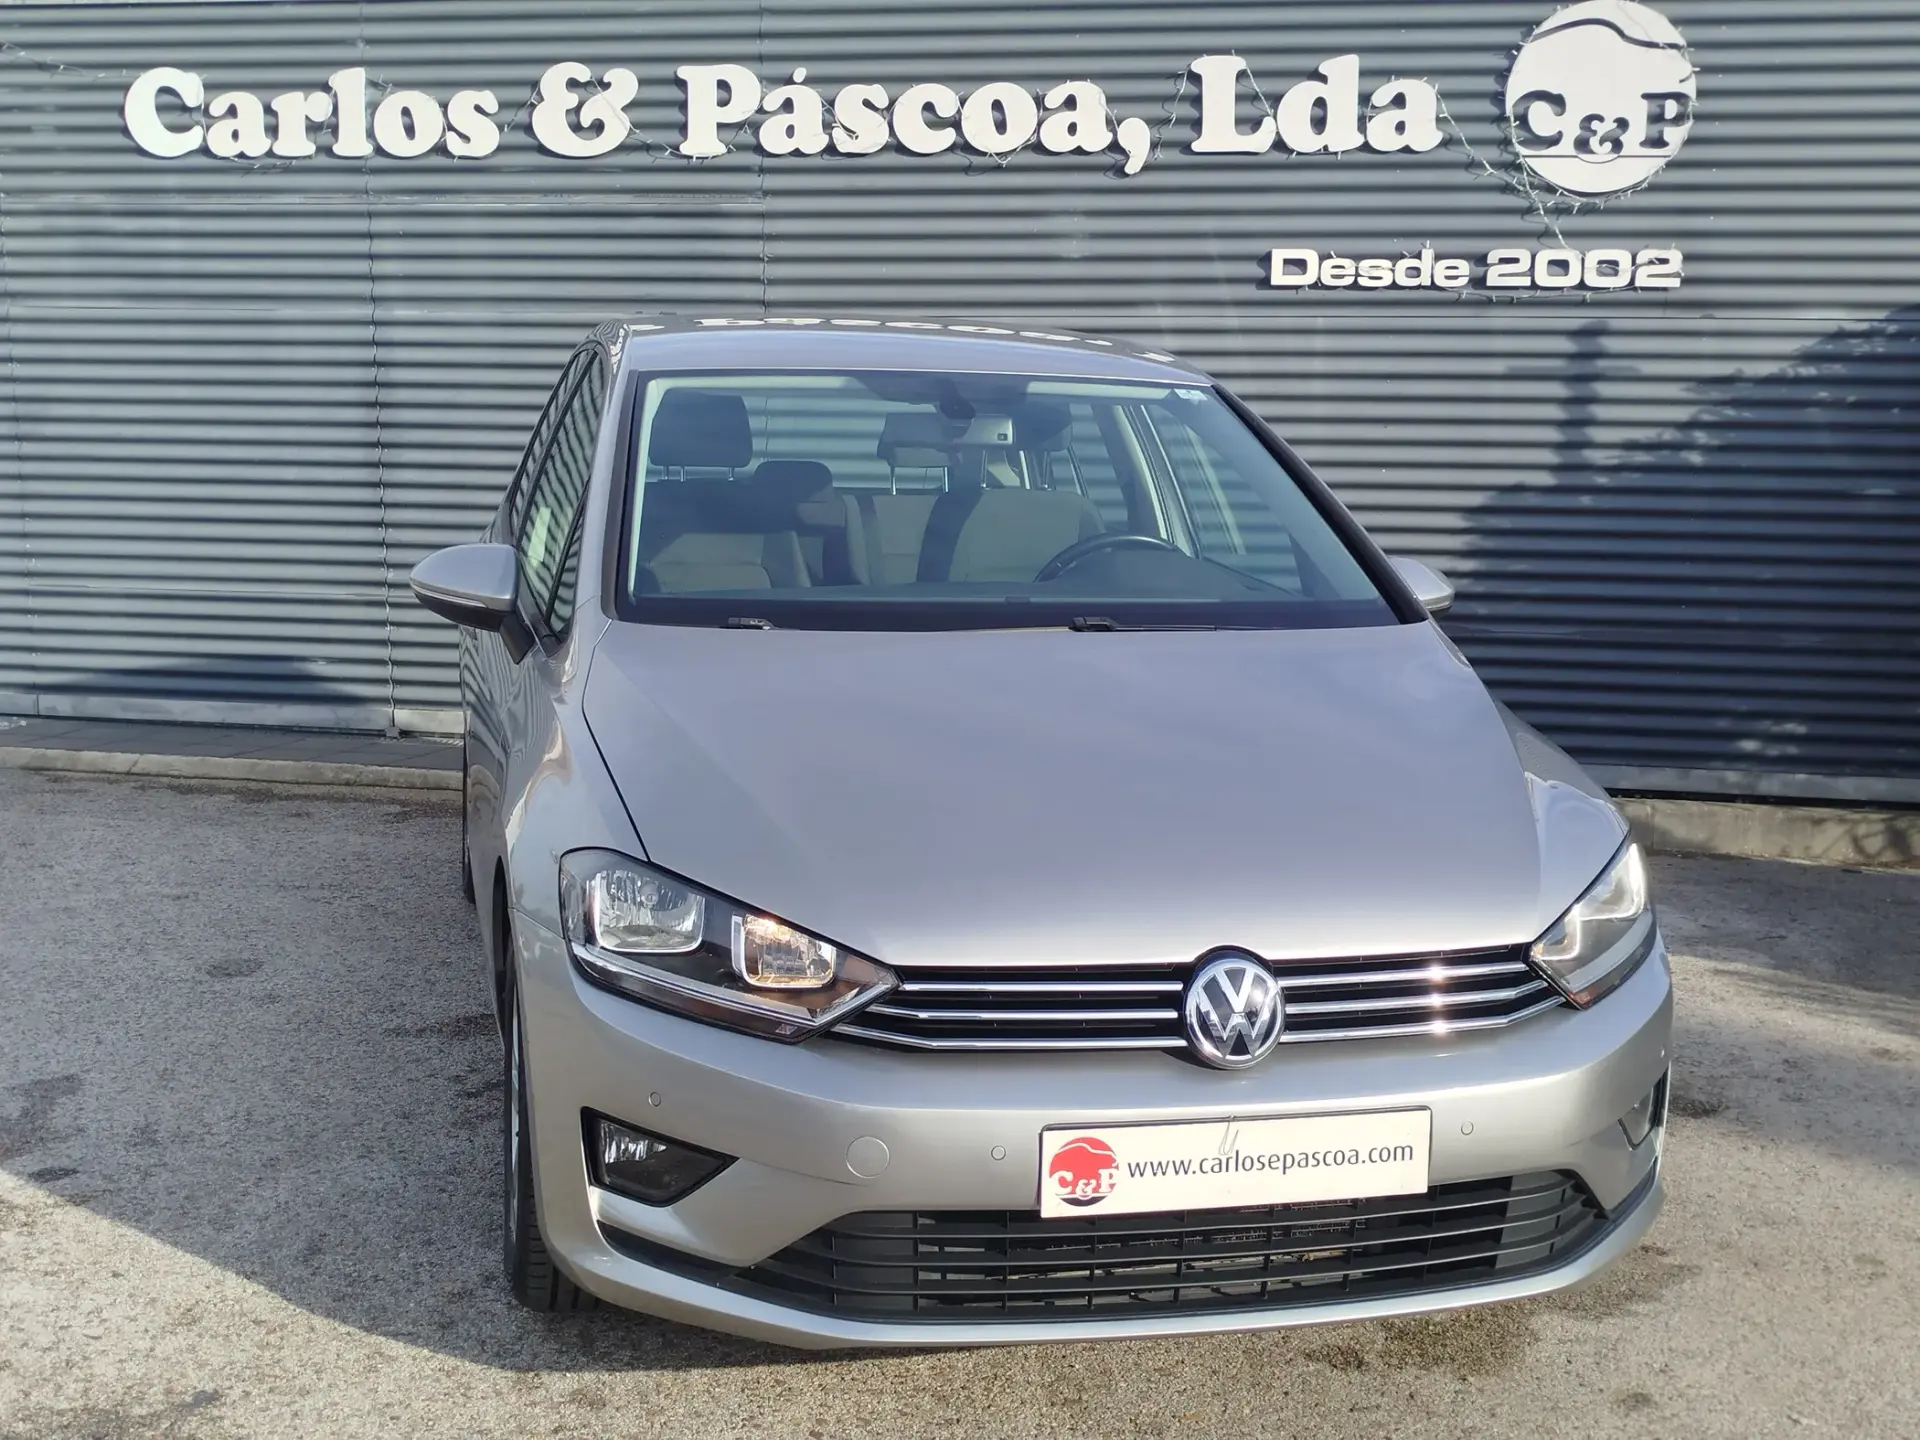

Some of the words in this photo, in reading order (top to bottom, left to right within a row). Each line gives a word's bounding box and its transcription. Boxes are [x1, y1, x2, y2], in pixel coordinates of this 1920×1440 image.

[125, 66, 500, 158] Carlos
[531, 61, 639, 157] &
[676, 63, 1151, 175] Páscoa,
[1190, 54, 1443, 154] Lda
[1270, 247, 1470, 288] Desde
[1486, 248, 1684, 289] 2002
[1187, 960, 1283, 1066] VW
[1127, 1143, 1414, 1179] www.carlosepascoa.com
